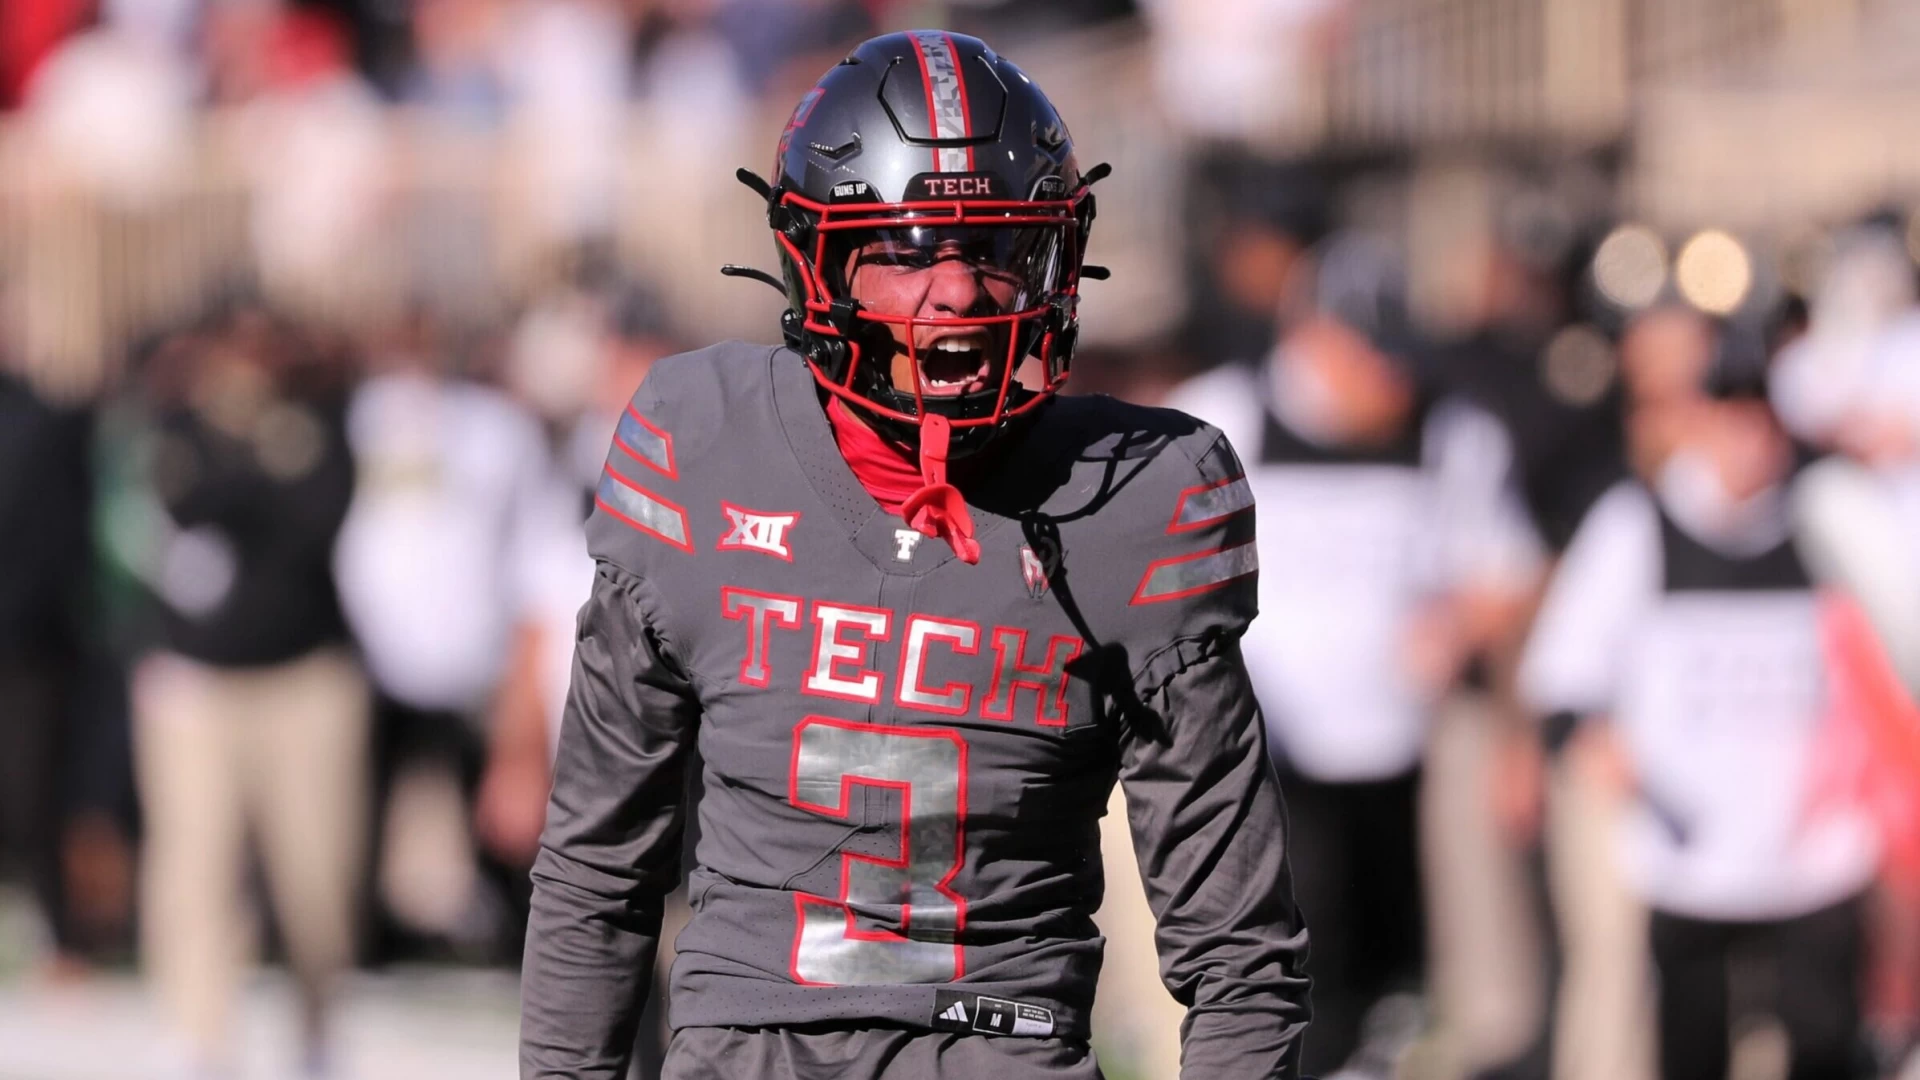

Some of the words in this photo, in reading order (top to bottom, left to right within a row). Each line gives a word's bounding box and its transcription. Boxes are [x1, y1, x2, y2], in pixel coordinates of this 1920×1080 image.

[835, 185, 854, 197] GUNS
[856, 183, 867, 195] UP
[924, 178, 990, 196] TECH
[720, 585, 1084, 726] TECH
[789, 715, 969, 987] 3
[990, 1013, 1002, 1027] M
